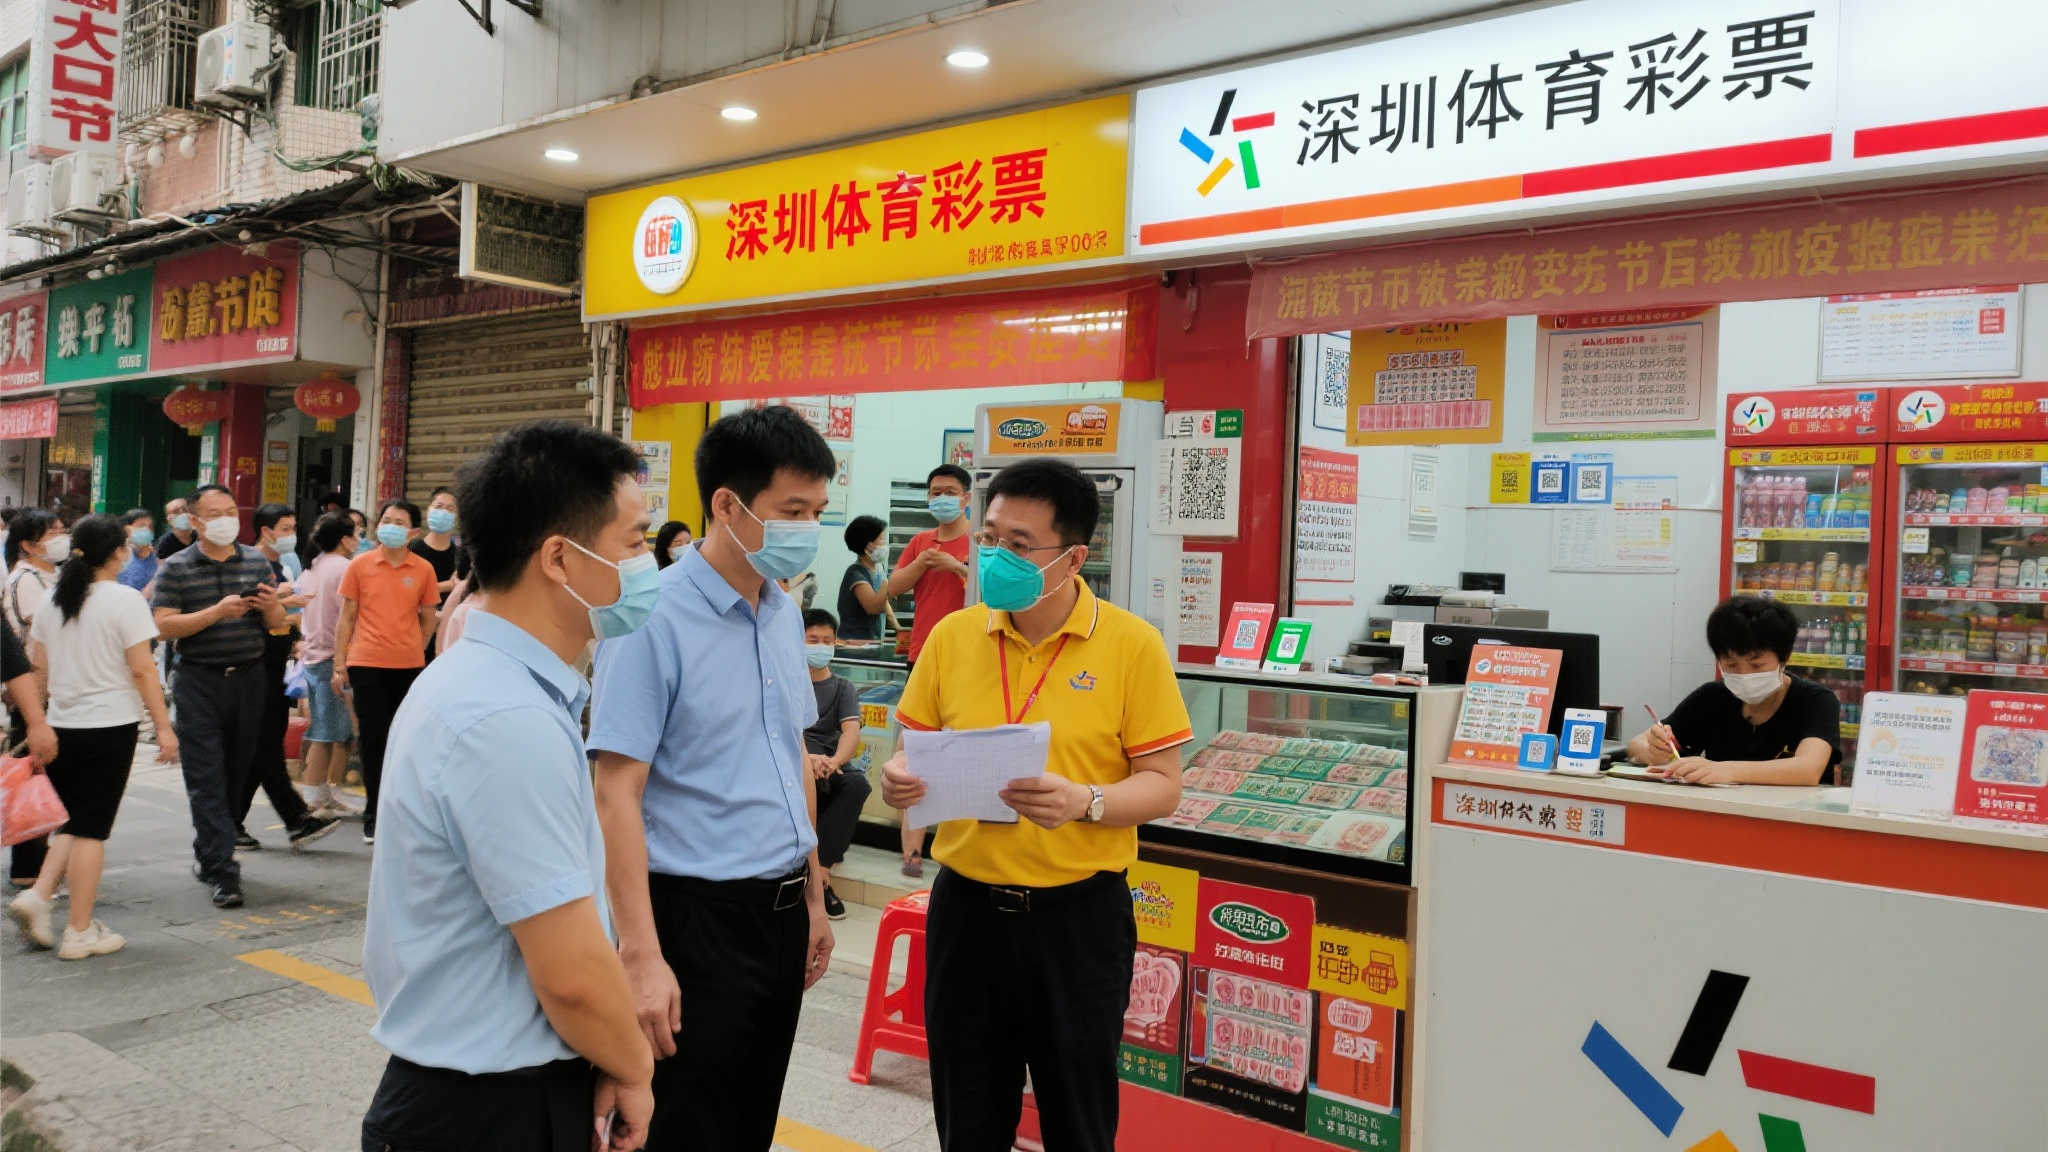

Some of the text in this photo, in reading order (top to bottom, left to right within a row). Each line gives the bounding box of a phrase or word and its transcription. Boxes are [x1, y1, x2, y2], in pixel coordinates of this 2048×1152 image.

[51, 0, 117, 142] 大口节
[1297, 11, 1815, 166] 深圳体育彩票
[726, 148, 1047, 261] 深圳体育彩票
